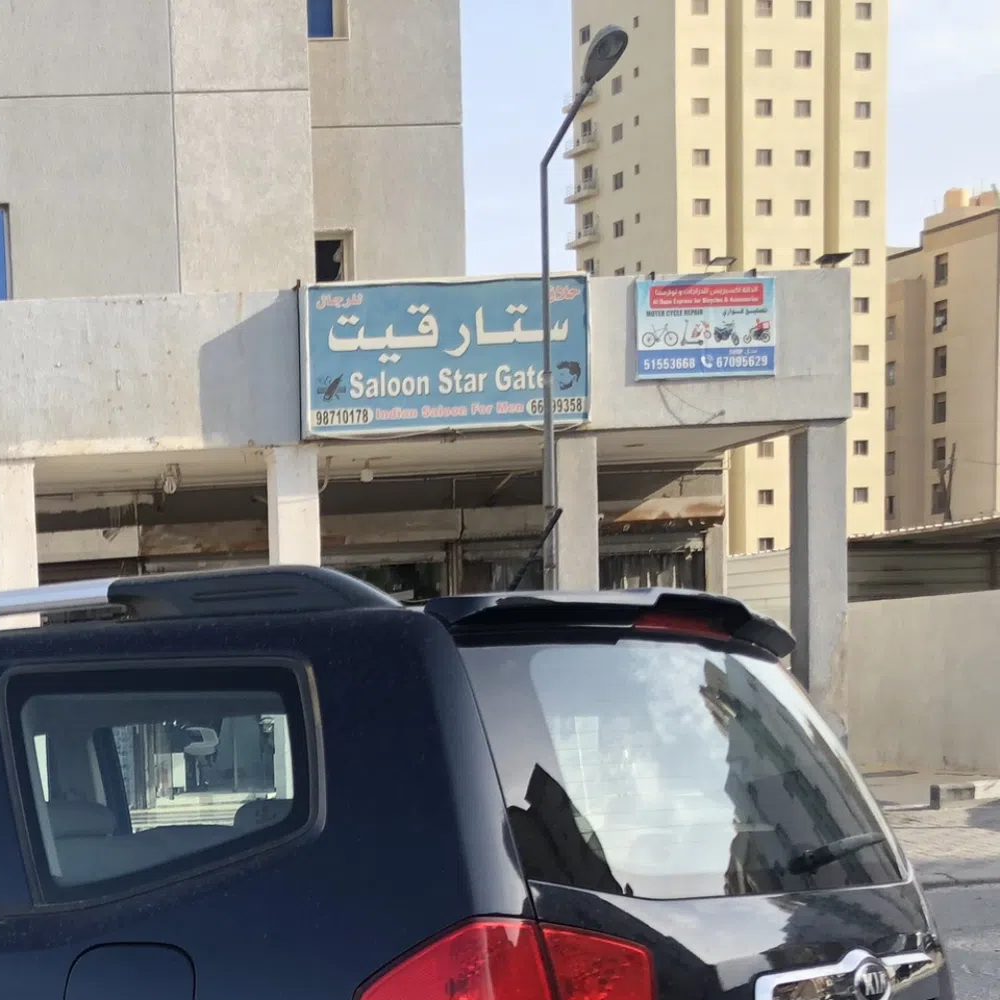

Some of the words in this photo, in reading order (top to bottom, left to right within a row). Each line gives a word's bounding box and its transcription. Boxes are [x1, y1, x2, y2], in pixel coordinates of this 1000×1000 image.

[328, 303, 439, 364] قيت
[441, 303, 569, 357] ستار
[643, 357, 696, 370] 51553668
[716, 355, 768, 368] 67095629
[349, 371, 430, 400] Saloon
[438, 367, 488, 395] Star
[376, 407, 418, 420] Indian
[421, 405, 467, 418] Saloon
[471, 402, 493, 415] For
[531, 398, 582, 413] 6699358
[316, 408, 369, 425] 98710178
